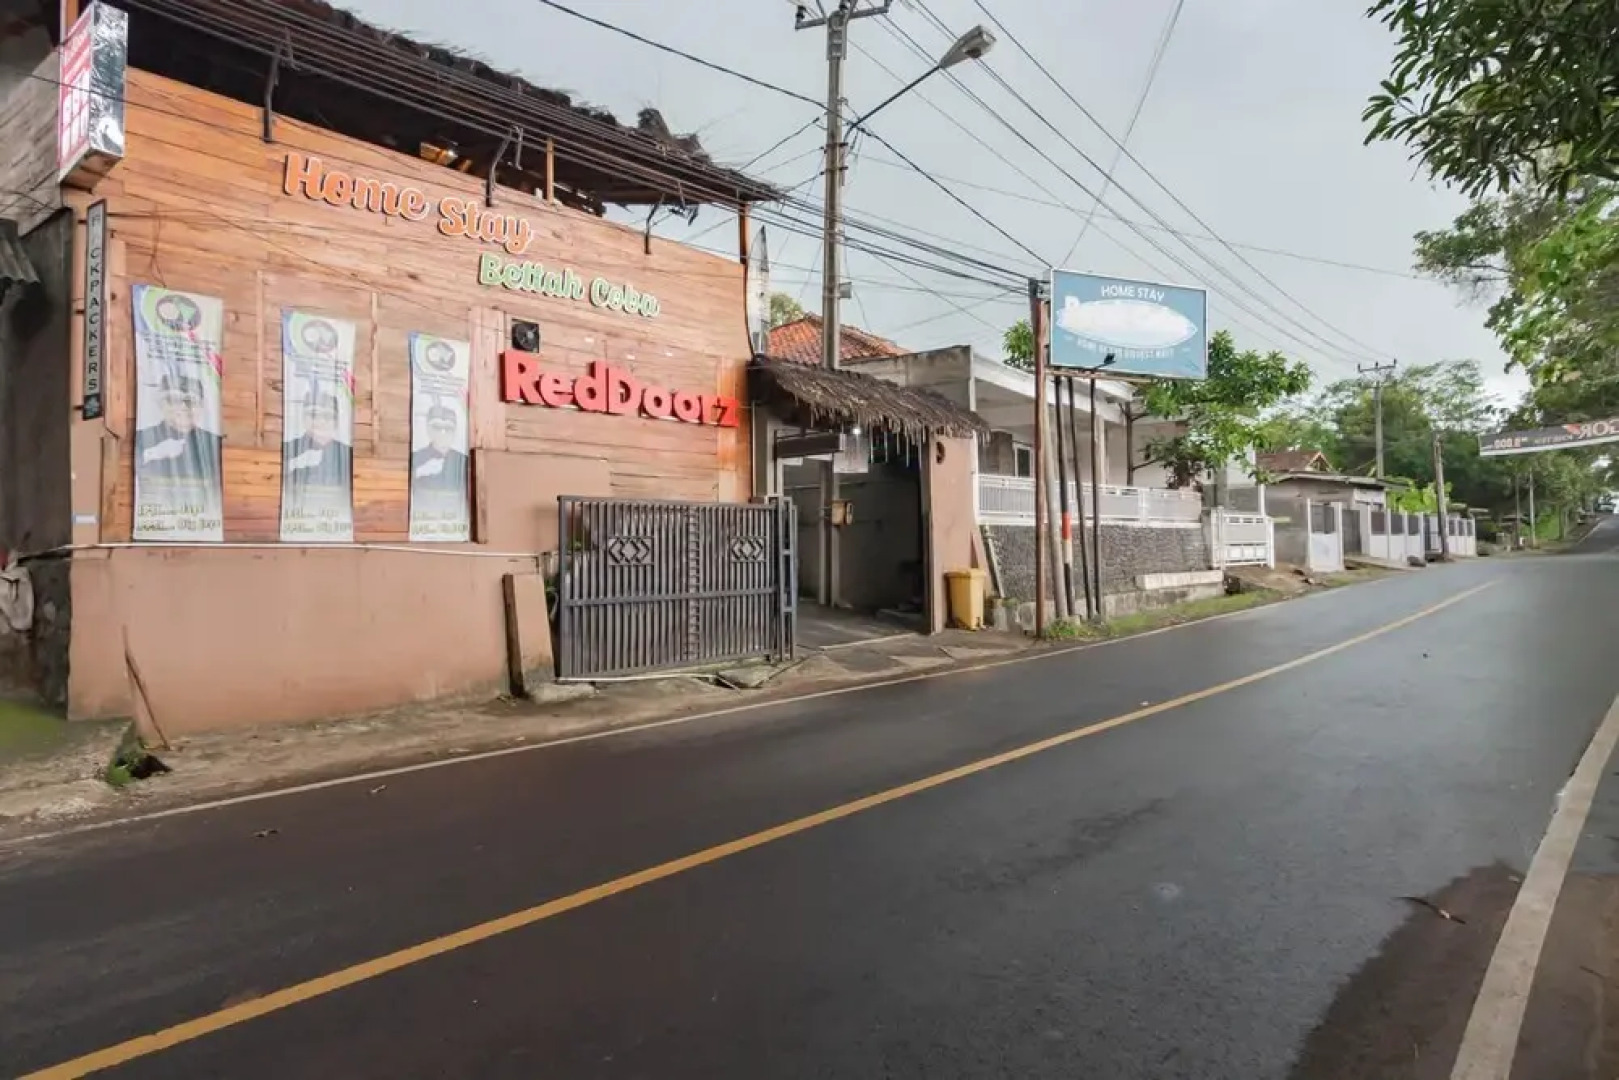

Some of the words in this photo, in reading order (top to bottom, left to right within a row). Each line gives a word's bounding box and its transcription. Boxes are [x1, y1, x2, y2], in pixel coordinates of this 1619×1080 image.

[284, 153, 429, 221] Home
[438, 197, 535, 254] Stay
[88, 213, 101, 391] CKPACKERS
[479, 252, 584, 301] Bettah
[590, 277, 661, 317] Coba
[1101, 285, 1136, 297] HOME
[1137, 288, 1165, 301] STAY
[500, 350, 740, 427] RedDoorz
